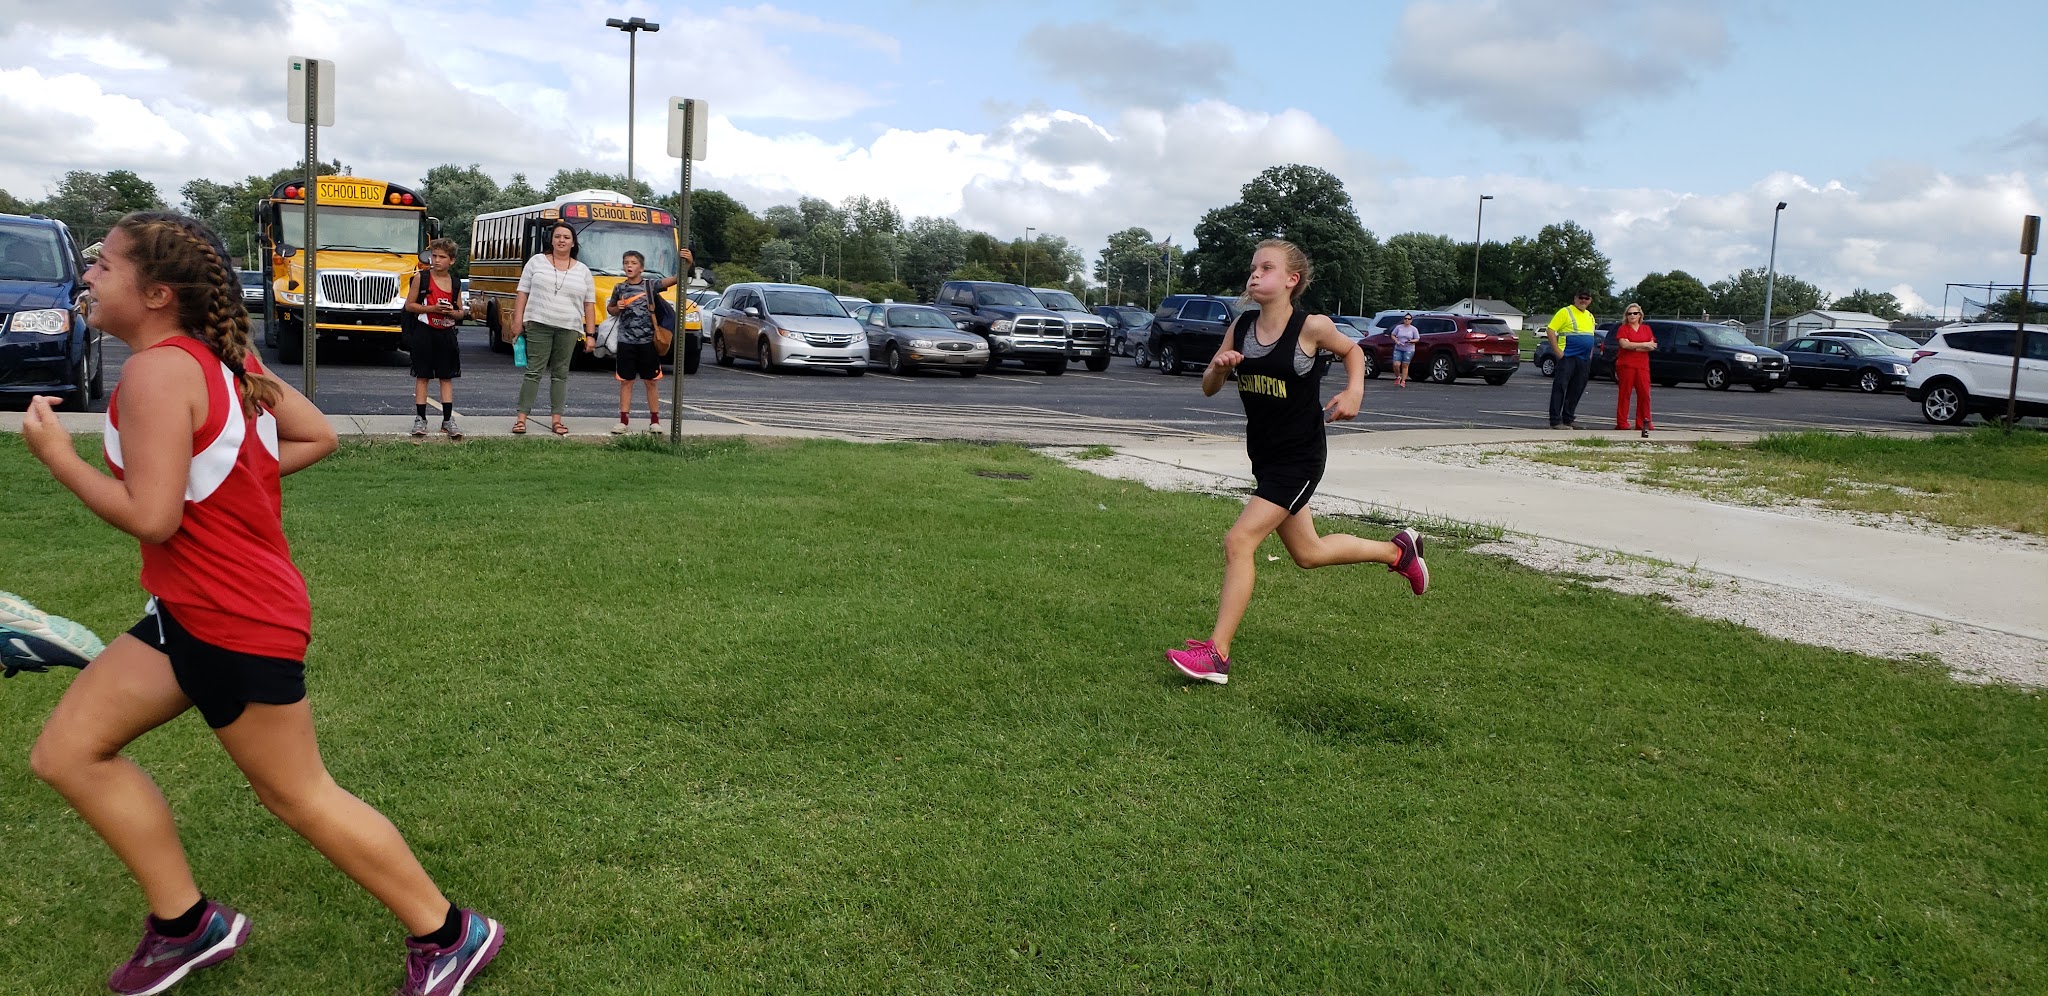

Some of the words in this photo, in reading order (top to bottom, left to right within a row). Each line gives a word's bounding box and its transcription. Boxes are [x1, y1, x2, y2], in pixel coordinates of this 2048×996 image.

[320, 183, 359, 199] SCHOOL
[360, 186, 380, 201] BUS
[592, 207, 629, 220] SCHOOL
[630, 210, 647, 222] BUS
